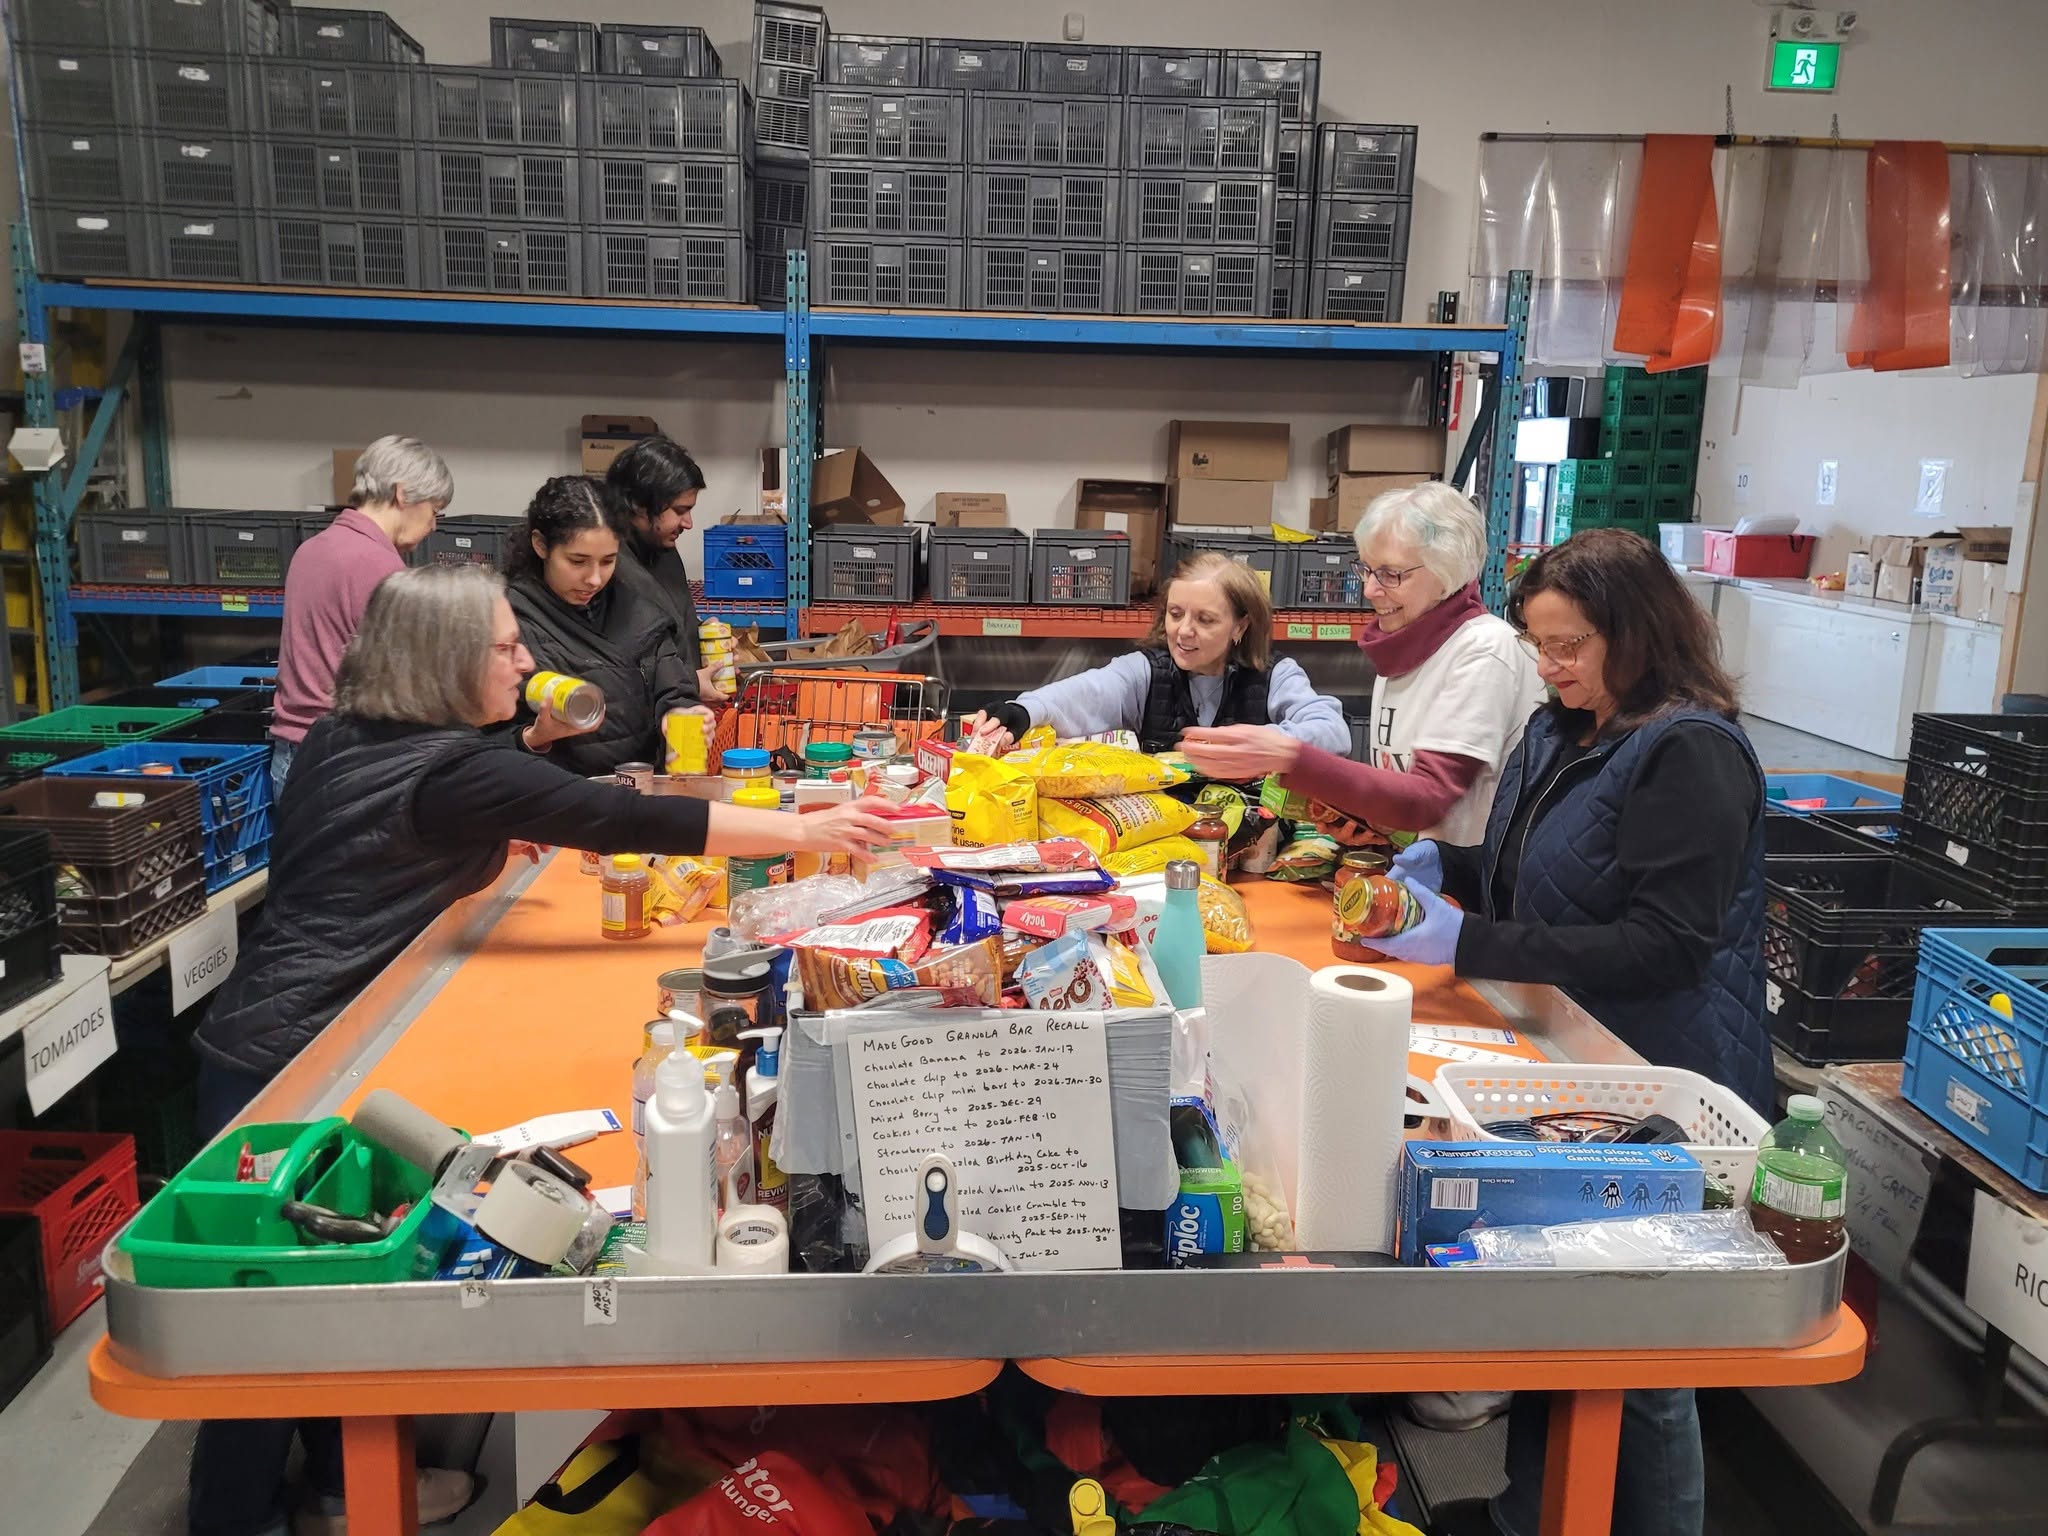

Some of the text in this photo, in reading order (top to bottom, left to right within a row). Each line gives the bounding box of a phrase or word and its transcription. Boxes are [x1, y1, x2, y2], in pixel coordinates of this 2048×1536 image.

[1737, 474, 1748, 488] 10
[1106, 798, 1132, 830] elbow
[960, 838, 985, 848] usage
[771, 865, 784, 874] Kraft
[183, 945, 228, 988] VEGGIES
[946, 1029, 998, 1042] GRANOLA
[1009, 1023, 1033, 1036] BAR
[1046, 1018, 1090, 1032] RECALL
[31, 1007, 105, 1073] TOMATOES
[920, 1055, 967, 1065] Banana
[977, 1050, 991, 1058] to
[954, 1070, 968, 1079] to
[983, 1082, 1007, 1092] bars
[1013, 1079, 1026, 1088] to
[944, 1105, 958, 1114] to
[873, 1130, 911, 1140] Cookies
[964, 1119, 978, 1129] to
[941, 1142, 954, 1150] to
[1537, 1147, 1602, 1155] Disposable
[880, 1164, 920, 1176] Chocola
[1037, 1149, 1060, 1158] Cake
[1066, 1147, 1079, 1156] to
[884, 1194, 914, 1203] Choco
[957, 1184, 984, 1195] zzled
[989, 1184, 1026, 1194] Vanilla
[1029, 1180, 1044, 1189] to
[884, 1197, 1086, 1221] Chocol zled Cookie Crumble to
[1232, 1196, 1242, 1215] 100
[1049, 1226, 1061, 1235] to
[721, 1475, 779, 1524] Hunger
